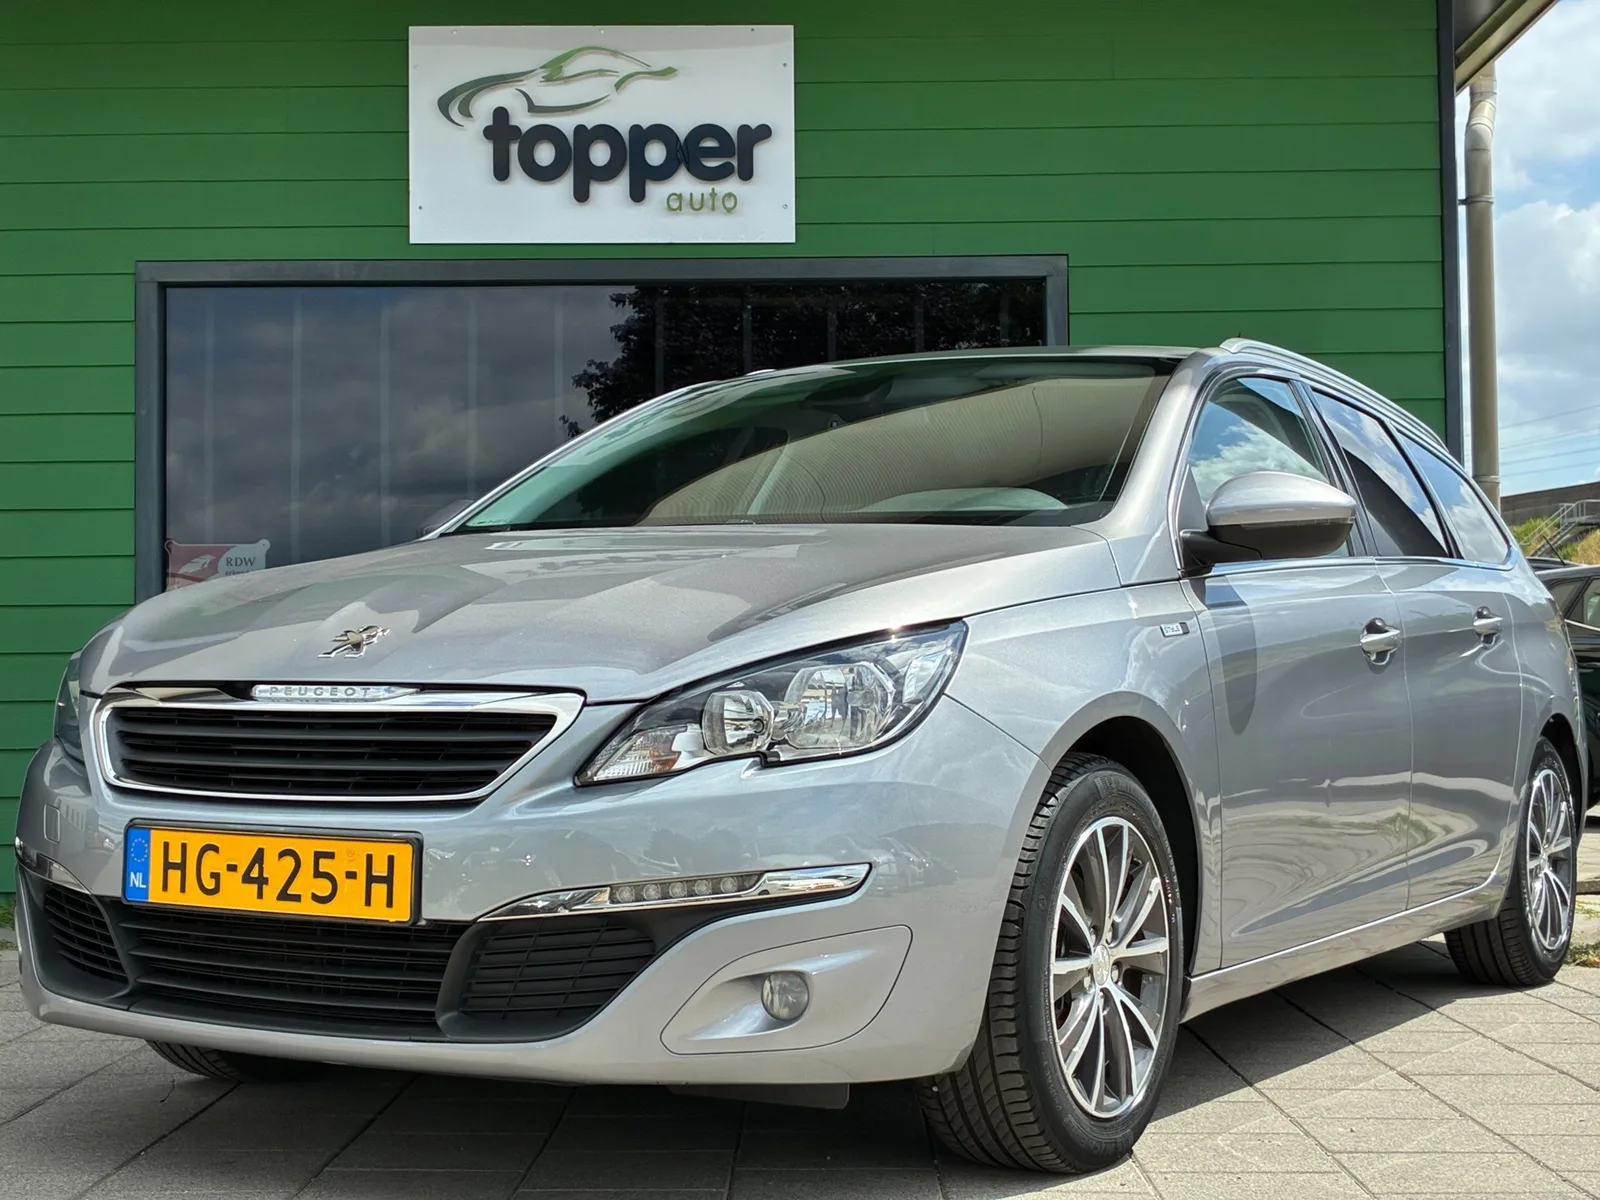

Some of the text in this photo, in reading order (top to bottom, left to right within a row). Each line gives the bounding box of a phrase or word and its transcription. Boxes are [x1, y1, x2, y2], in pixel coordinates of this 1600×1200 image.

[482, 106, 772, 203] topper
[666, 187, 738, 213] auto
[226, 556, 256, 566] RDW
[268, 686, 372, 697] PEUGEOT
[129, 871, 147, 889] NL
[162, 841, 395, 908] HG-425-H
